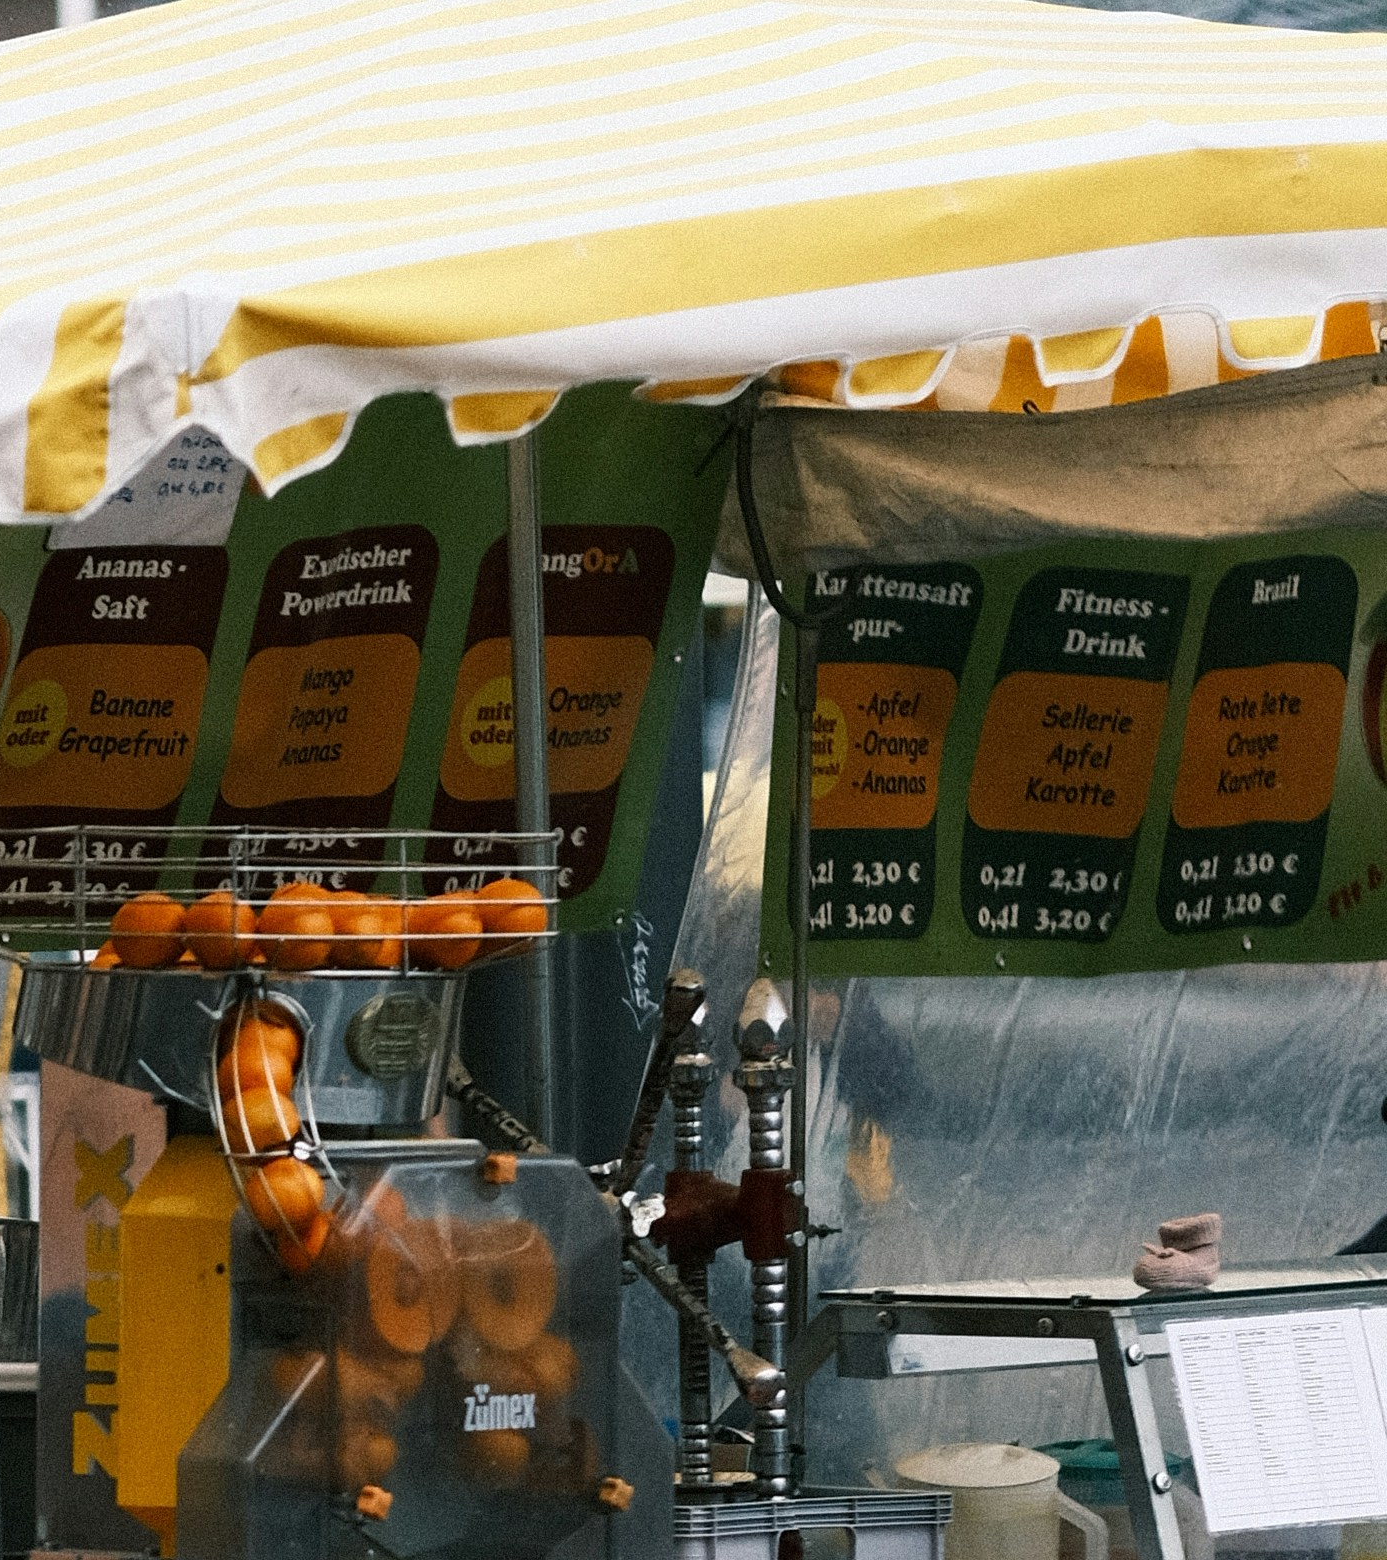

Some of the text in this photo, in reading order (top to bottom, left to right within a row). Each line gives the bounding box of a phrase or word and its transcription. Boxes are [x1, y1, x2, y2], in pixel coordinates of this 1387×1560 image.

[75, 554, 173, 581] Ananas
[541, 546, 641, 579] angOrA
[279, 578, 413, 617] Powerdrink
[814, 571, 973, 607] Karttensaft
[1056, 587, 1154, 618] Fitness
[91, 593, 151, 621] Saft
[1063, 628, 1146, 659] Drink
[300, 666, 355, 696] Mango
[15, 704, 50, 724] mit
[90, 690, 174, 718] Banane
[476, 702, 514, 721] mit
[548, 687, 623, 716] Orange
[1218, 695, 1256, 721] Rote
[288, 704, 349, 735] Papaya
[813, 714, 837, 733] der
[1042, 703, 1133, 733] Sellerie
[6, 728, 50, 747] oder
[58, 728, 189, 762] Grapefruit
[547, 726, 613, 748] Ananas
[279, 742, 343, 768] Ananas
[1047, 743, 1113, 774] Apfel
[1025, 777, 1116, 807] Karotte
[1218, 767, 1276, 796] Karotte
[228, 832, 269, 857] 02l
[570, 826, 589, 848] €
[59, 841, 124, 866] 230
[810, 859, 922, 889] ,2l 2,30 €
[980, 862, 1026, 890] 0,2l
[1048, 867, 1108, 895] 2,30
[1180, 855, 1220, 887] 0,2l
[1282, 852, 1300, 875] €
[809, 900, 915, 931] ,4l 3,20 €
[978, 903, 1019, 932] 0,4l
[1033, 907, 1092, 933] 3,20
[1175, 894, 1214, 927] 0,4l
[1268, 892, 1287, 915] €
